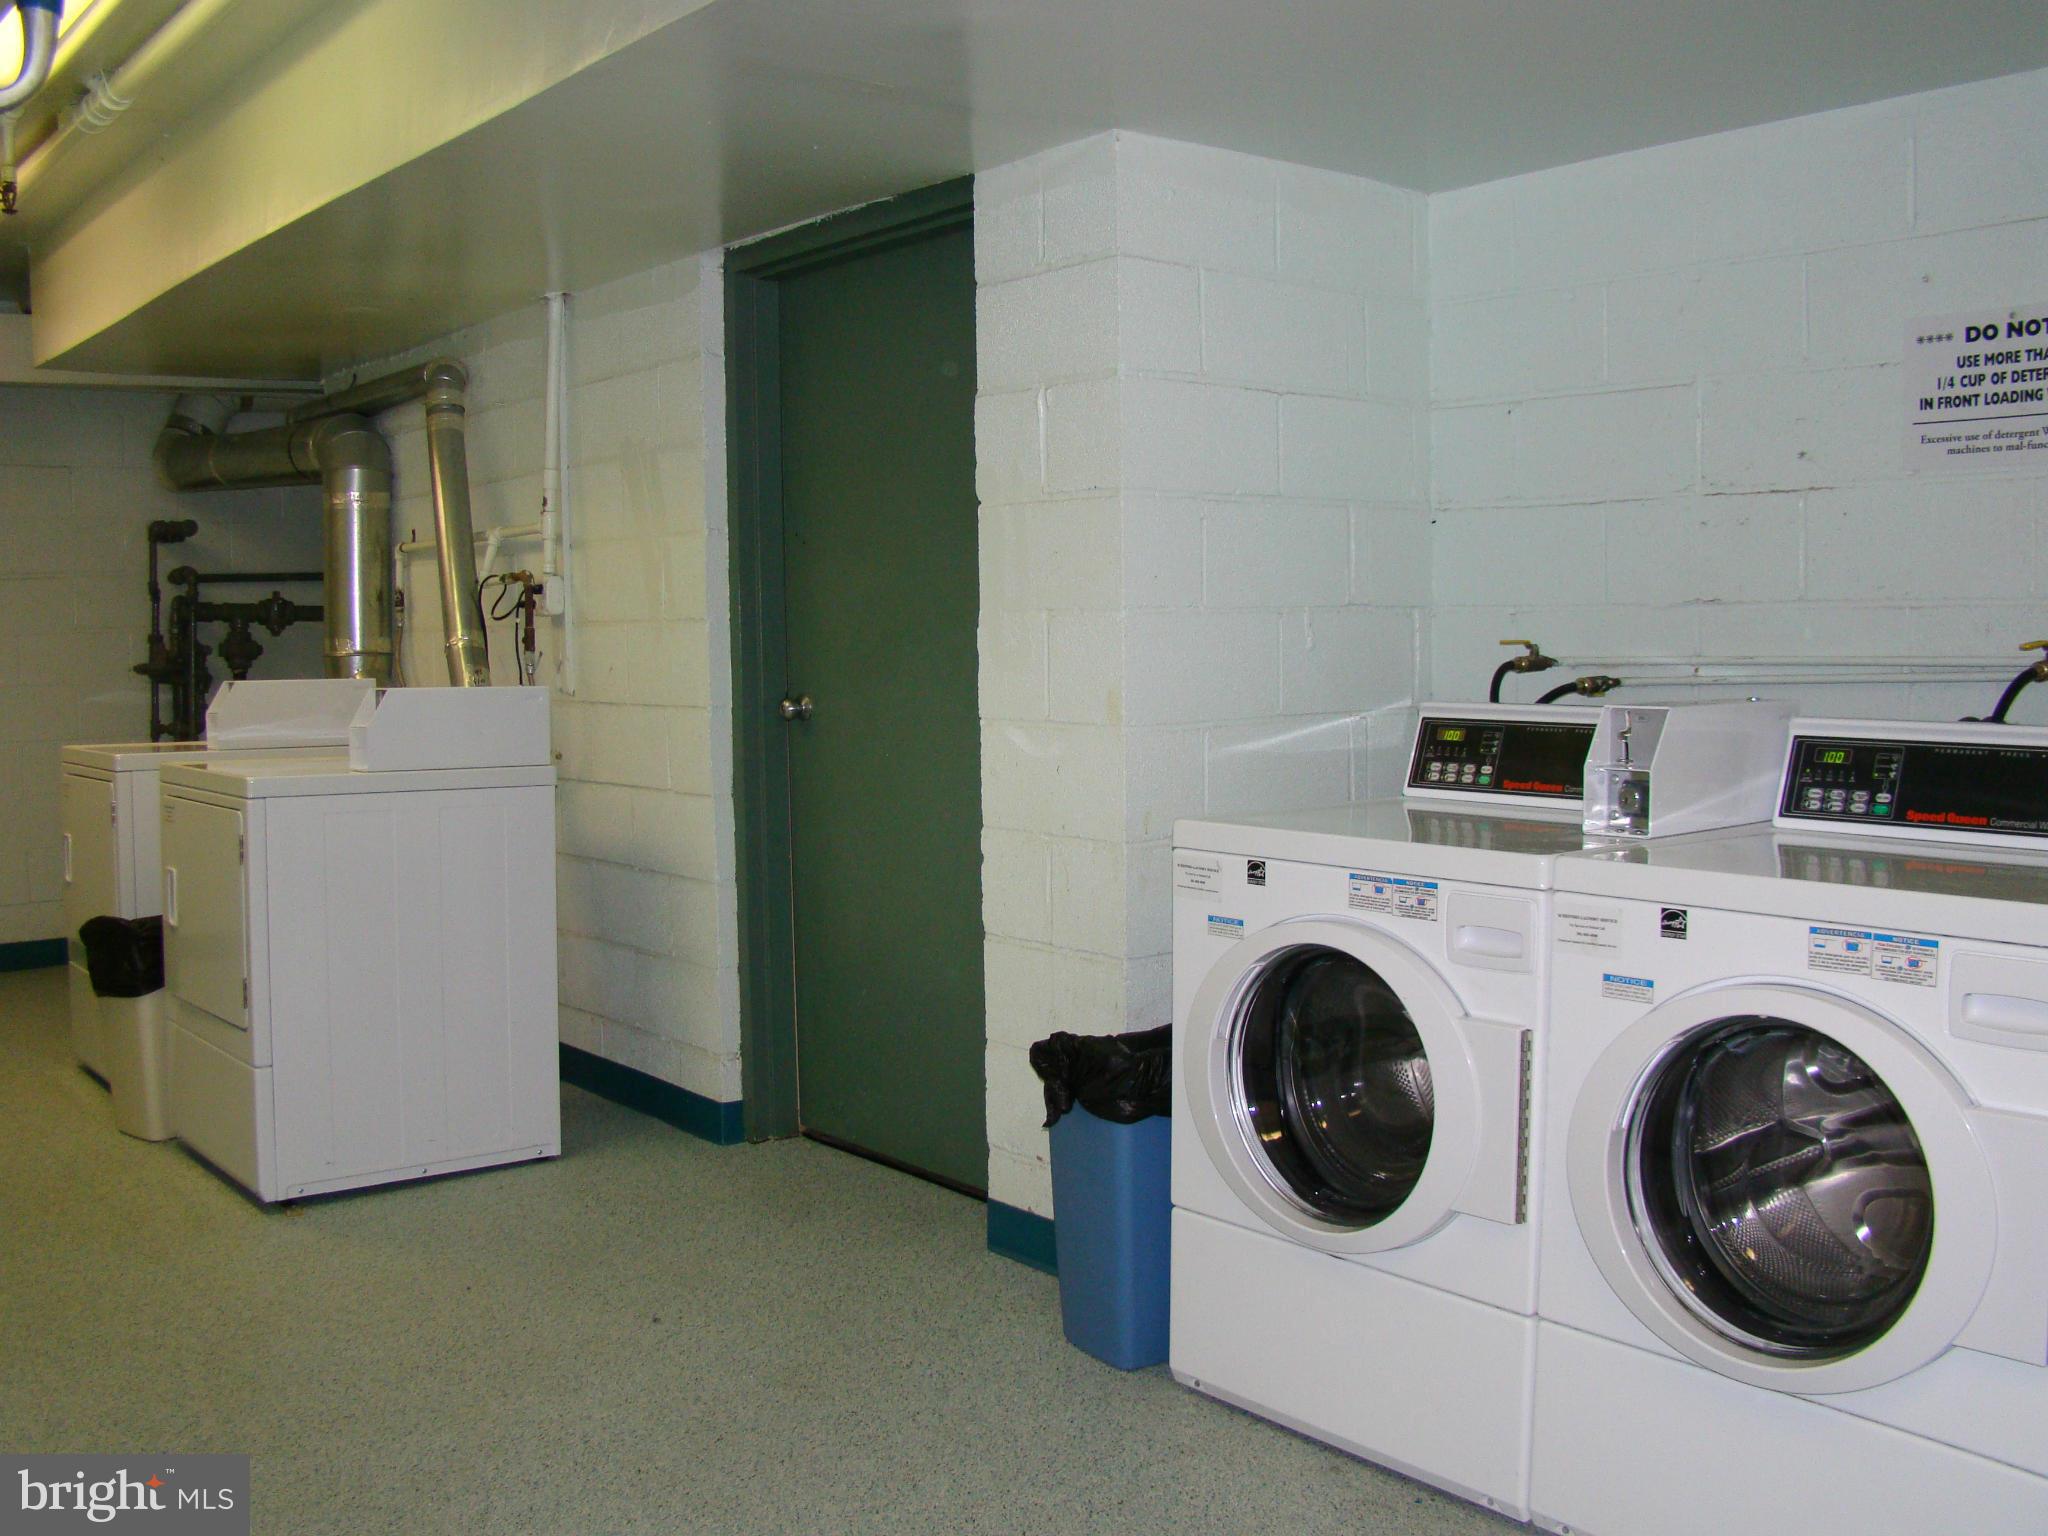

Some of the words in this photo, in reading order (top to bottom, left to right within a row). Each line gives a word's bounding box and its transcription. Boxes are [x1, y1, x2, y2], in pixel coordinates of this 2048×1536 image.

[1965, 324, 1998, 343] DO
[2006, 317, 2048, 339] NOT
[1957, 354, 1980, 369] USE
[1984, 350, 2021, 366] MORE
[1937, 376, 1954, 390] 1/4
[1960, 374, 1986, 388] CUP
[1990, 371, 2007, 385] OF
[1920, 398, 1933, 411] IN
[1938, 394, 1980, 410] FRONT
[1984, 388, 2043, 406] LOADING
[1920, 433, 1962, 444] Excessive
[1965, 434, 1980, 442] use
[1982, 430, 1994, 441] of
[1995, 429, 2039, 441] detergent
[1947, 444, 1991, 455] machines
[1993, 444, 2003, 452] to
[1444, 730, 1461, 741] 100
[1823, 752, 1845, 764] 100
[1906, 809, 1945, 822] Speed
[1609, 975, 1648, 987] NOTICE
